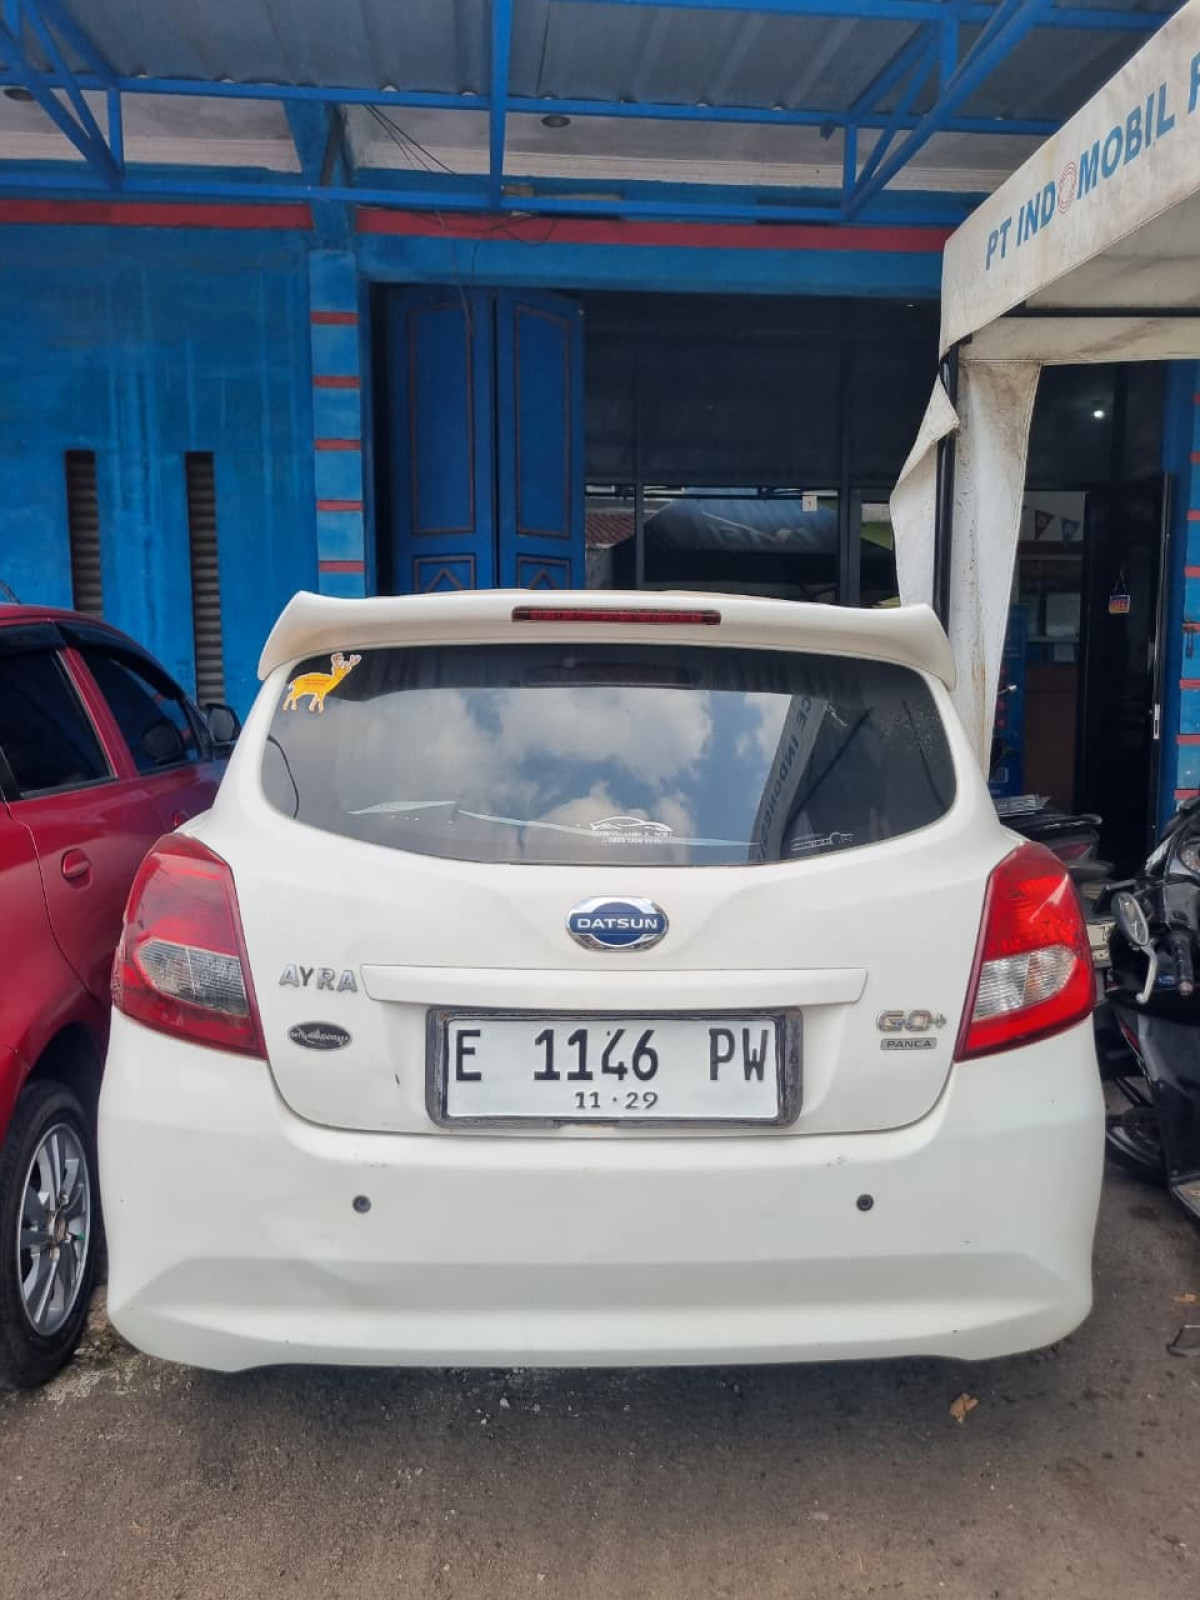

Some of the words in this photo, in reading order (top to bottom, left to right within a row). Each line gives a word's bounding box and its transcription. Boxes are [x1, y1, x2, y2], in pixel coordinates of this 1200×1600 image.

[985, 216, 1012, 271] PT
[1016, 81, 1176, 247] INDOMOBIL
[577, 917, 658, 930] DATSUN
[278, 963, 358, 992] AYRA
[455, 1029, 483, 1081] E
[533, 1028, 660, 1081] 1146
[708, 1027, 770, 1081] PW
[886, 1040, 932, 1049] PANCA
